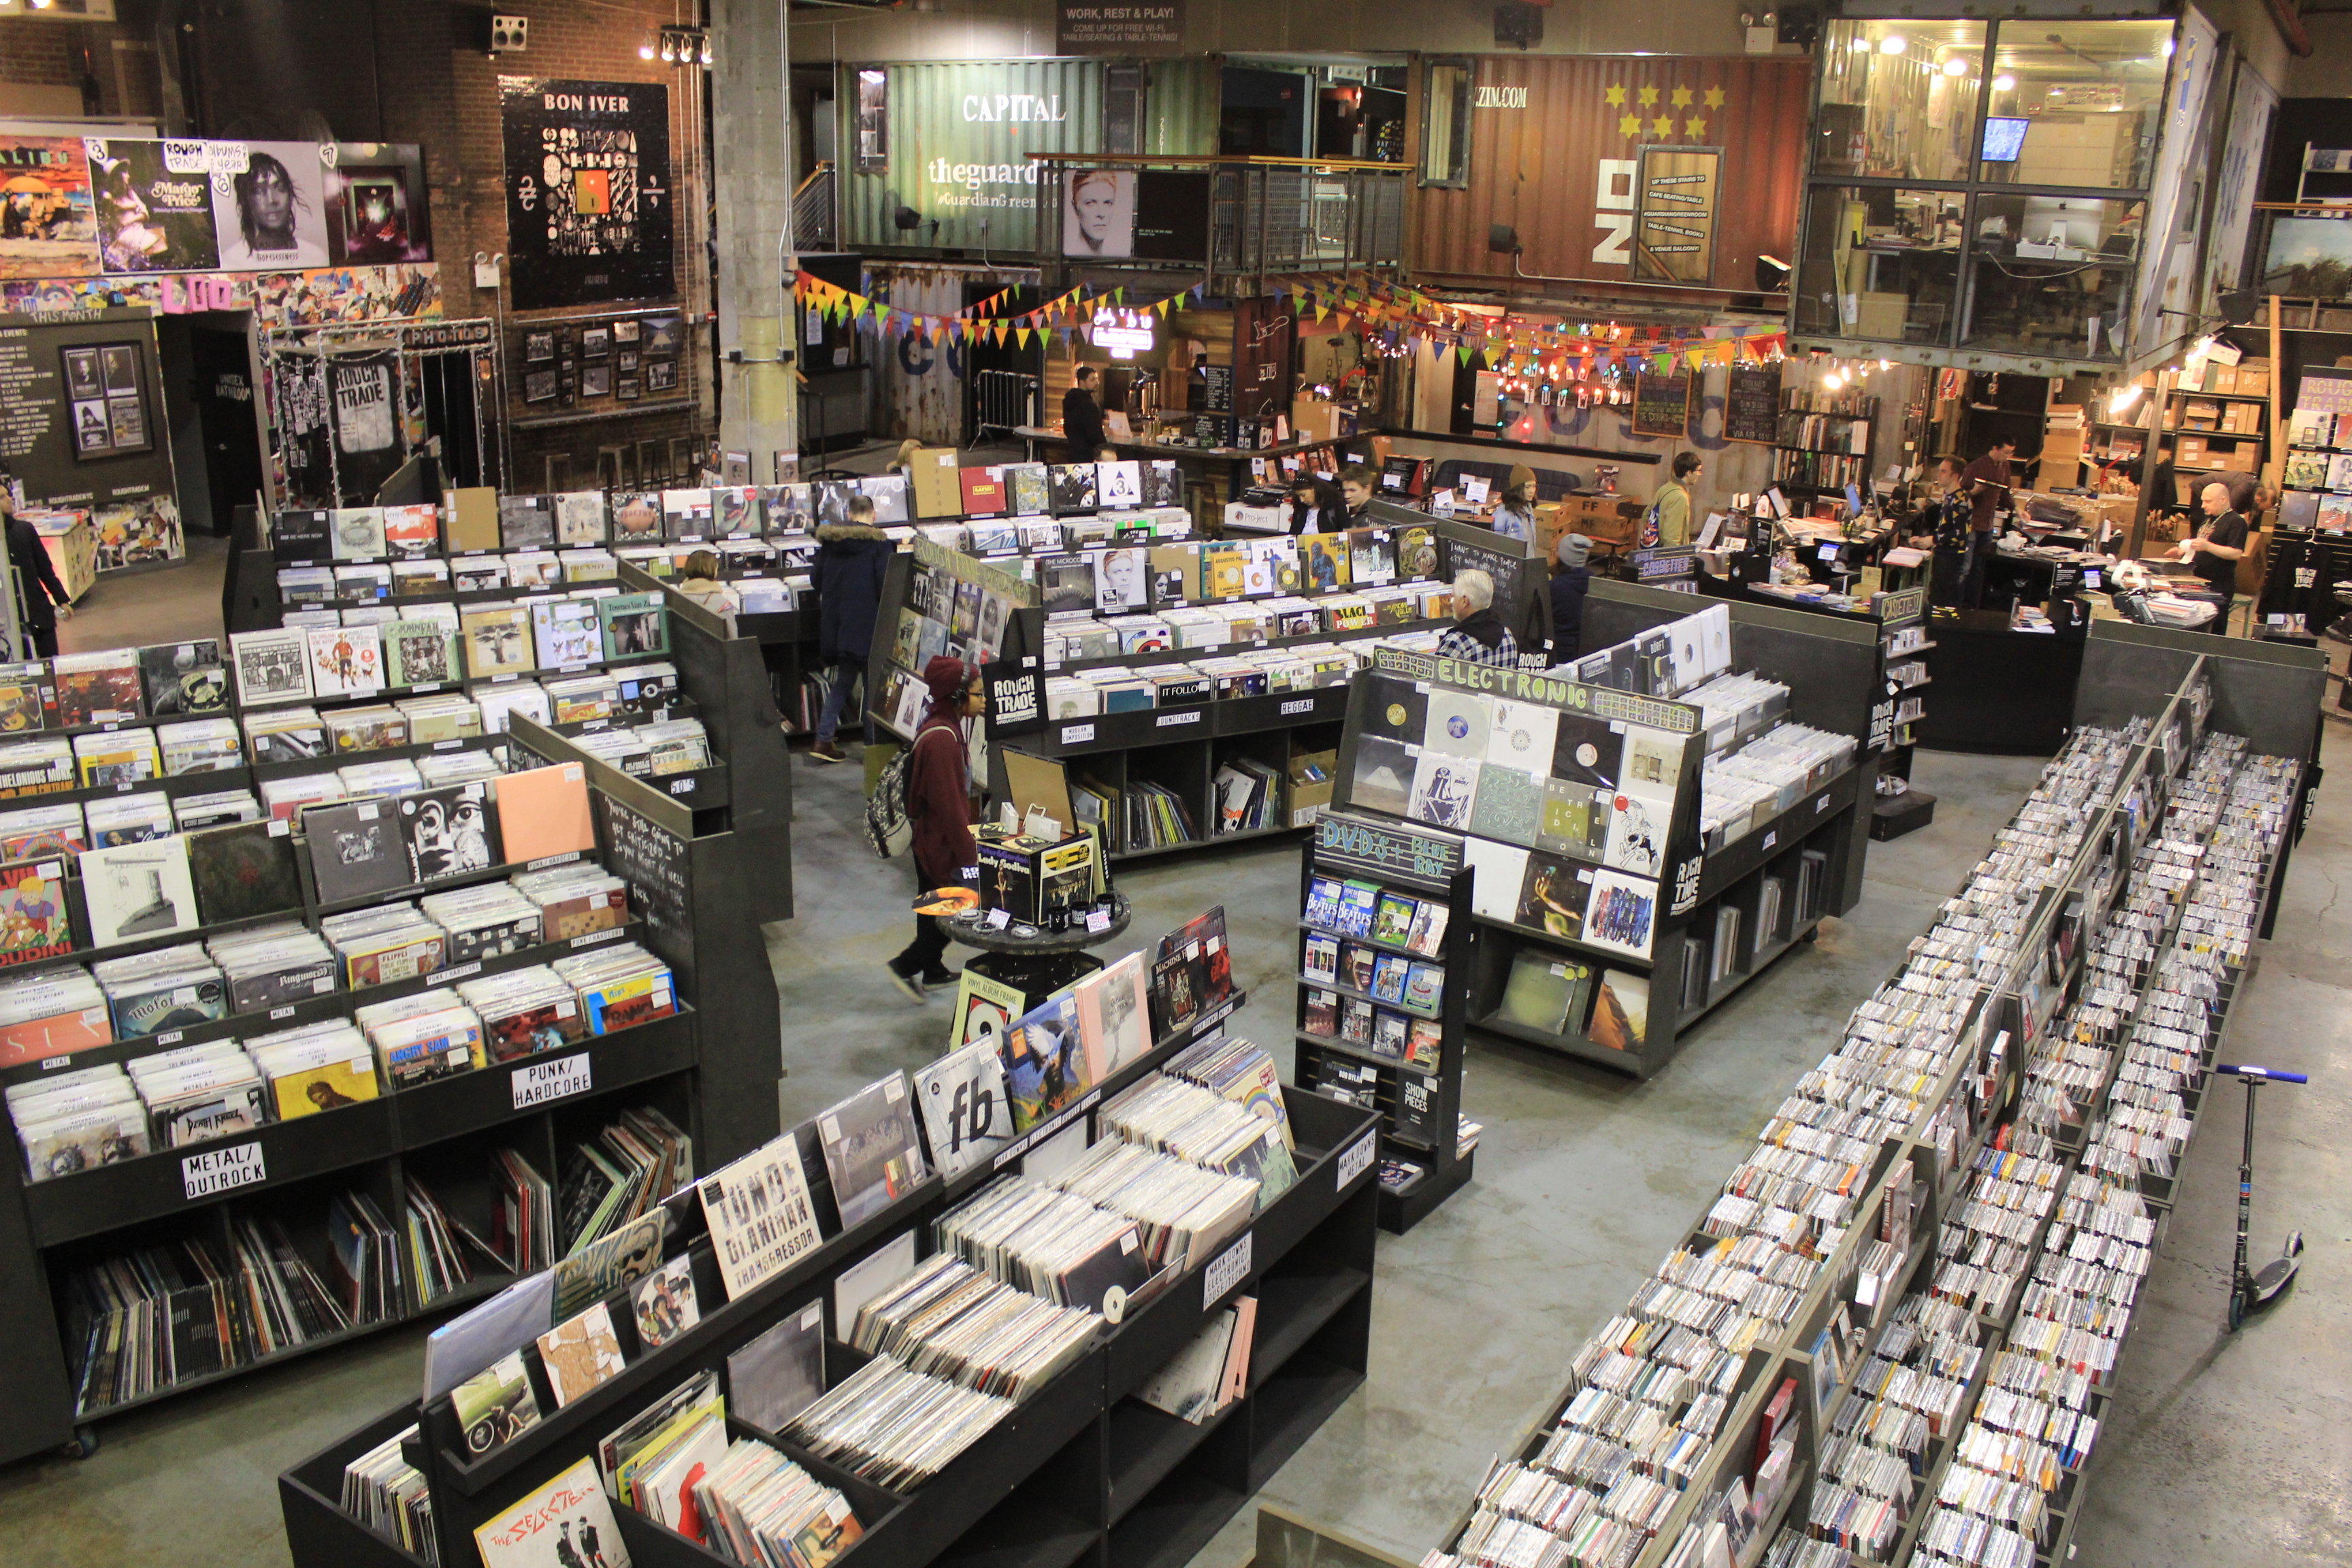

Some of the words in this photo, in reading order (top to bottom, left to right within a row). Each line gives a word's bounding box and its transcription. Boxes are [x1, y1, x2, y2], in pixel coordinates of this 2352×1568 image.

[1066, 8, 1101, 20] WORK,
[1104, 8, 1131, 18] REST
[1134, 8, 1141, 18] &
[1144, 8, 1174, 18] PLAY!
[1073, 24, 1094, 33] COME
[1096, 24, 1106, 33] UP
[1108, 24, 1123, 33] FOR
[1125, 24, 1143, 33] FREE
[544, 94, 583, 112] BON
[590, 95, 630, 112] IVER
[963, 95, 1066, 122] CAPITAL
[93, 144, 105, 160] 3
[167, 143, 202, 156] ROUGH
[169, 158, 203, 169] TRADE
[151, 182, 203, 197] Margo
[218, 178, 229, 193] 6
[162, 194, 201, 208] Price
[31, 310, 59, 323] THIS
[62, 308, 103, 322] MONTH
[412, 325, 489, 344] PHOTOS
[340, 384, 385, 410] TRADE
[1114, 479, 1125, 496] 3
[1582, 500, 1599, 511] FF
[1333, 605, 1367, 619] BLAC
[1336, 616, 1375, 630] POWER
[1518, 652, 1548, 668] ROUGH
[994, 674, 1035, 698] ROUGH
[1162, 687, 1171, 697] IT
[1438, 659, 1587, 710] ELECTRONIC
[996, 691, 1037, 714] TRADE
[1281, 699, 1313, 714] REGGAE
[1157, 712, 1200, 726] SOUNDTRACKS
[1062, 731, 1094, 743] COMPOSITION
[1068, 726, 1088, 735] MODERN
[47, 766, 74, 783] MONK
[673, 841, 683, 856] TO
[1323, 819, 1389, 860] DVD'S
[1412, 836, 1451, 860] BLUE
[979, 853, 998, 869] Lady
[1000, 858, 1030, 875] Godiva
[1414, 855, 1444, 879] RAY
[1307, 893, 1338, 915] BEATLES
[1337, 900, 1372, 926] BEATLES
[382, 950, 409, 962] FLIPPE
[1156, 956, 1181, 975] MACHINE
[968, 977, 981, 990] VINYL
[981, 982, 1000, 997] ALBUM
[1000, 991, 1018, 1005] FRAME
[272, 1007, 295, 1018] METAL
[159, 1032, 182, 1044] METAL
[389, 1043, 424, 1063] ANGRY
[44, 1057, 70, 1069] METAL
[529, 1058, 573, 1082] PUNK/
[515, 1075, 591, 1107] HARDCORE
[1405, 1081, 1428, 1101] SHOW
[1405, 1093, 1428, 1113] PIECES
[949, 1075, 993, 1155] fb
[186, 1115, 212, 1137] DEATH
[994, 1152, 1009, 1169] MARK
[1010, 1139, 1028, 1159] DOWNS
[1030, 1120, 1062, 1147] ELECTRONIC
[1081, 1091, 1101, 1110] TECHNO
[189, 1143, 254, 1175] METAL/
[1339, 1154, 1354, 1172] MARK
[1356, 1133, 1375, 1158] DOWNS
[1347, 1158, 1366, 1179] METAL
[186, 1163, 264, 1198] OUTROCK
[719, 1160, 801, 1233] TUNDE
[734, 1228, 815, 1288] TRANSGRESSOR
[1209, 1256, 1226, 1277] MARK
[1228, 1238, 1247, 1262] DOWNS
[1207, 1250, 1249, 1292] ELECTRONIC/
[1204, 1260, 1251, 1307] HOUSE/TECHNO
[490, 1533, 513, 1550] THE
